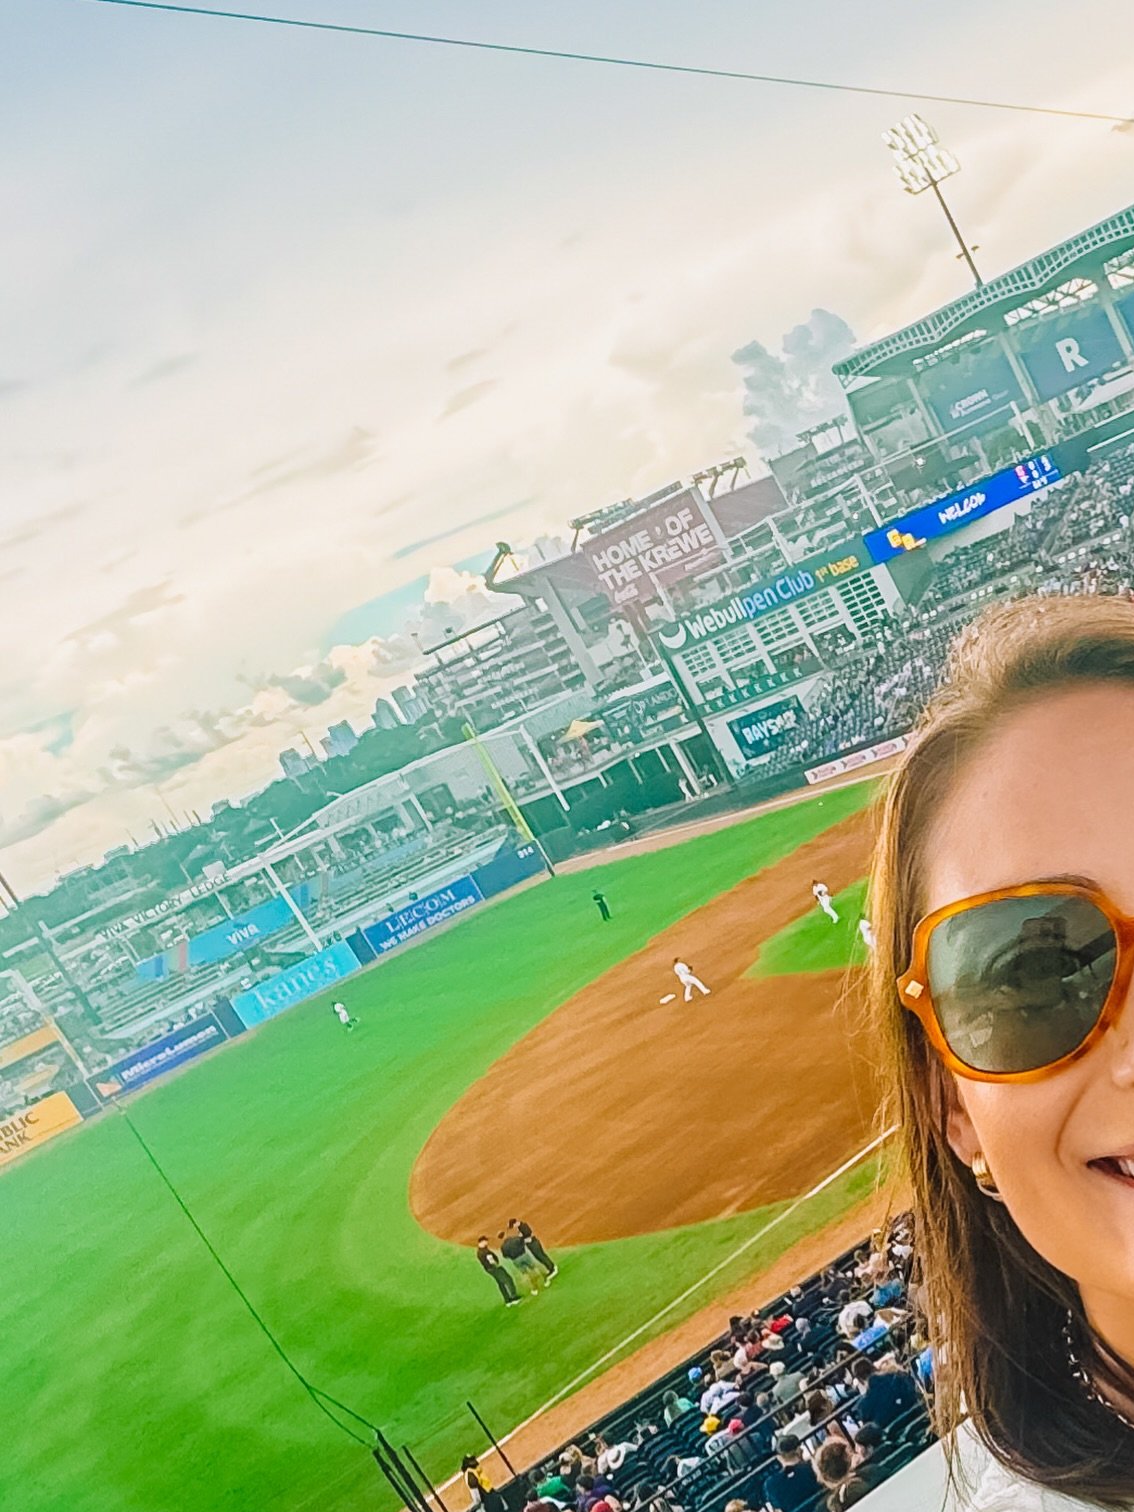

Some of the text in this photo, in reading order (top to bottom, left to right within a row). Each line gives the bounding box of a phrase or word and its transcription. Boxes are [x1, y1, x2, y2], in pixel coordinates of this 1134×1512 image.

[592, 529, 654, 572] HOME
[665, 507, 694, 537] OF
[598, 559, 643, 591] THE
[637, 522, 715, 573] KREWE
[685, 587, 778, 640] Webullpen
[775, 570, 815, 599] Club
[828, 555, 860, 577] base
[101, 873, 232, 940] VIVA VICTORY LEDGE
[226, 923, 261, 946] VIVA
[379, 895, 476, 951] WE MAKE DOCTORS
[385, 889, 456, 933] LECOM
